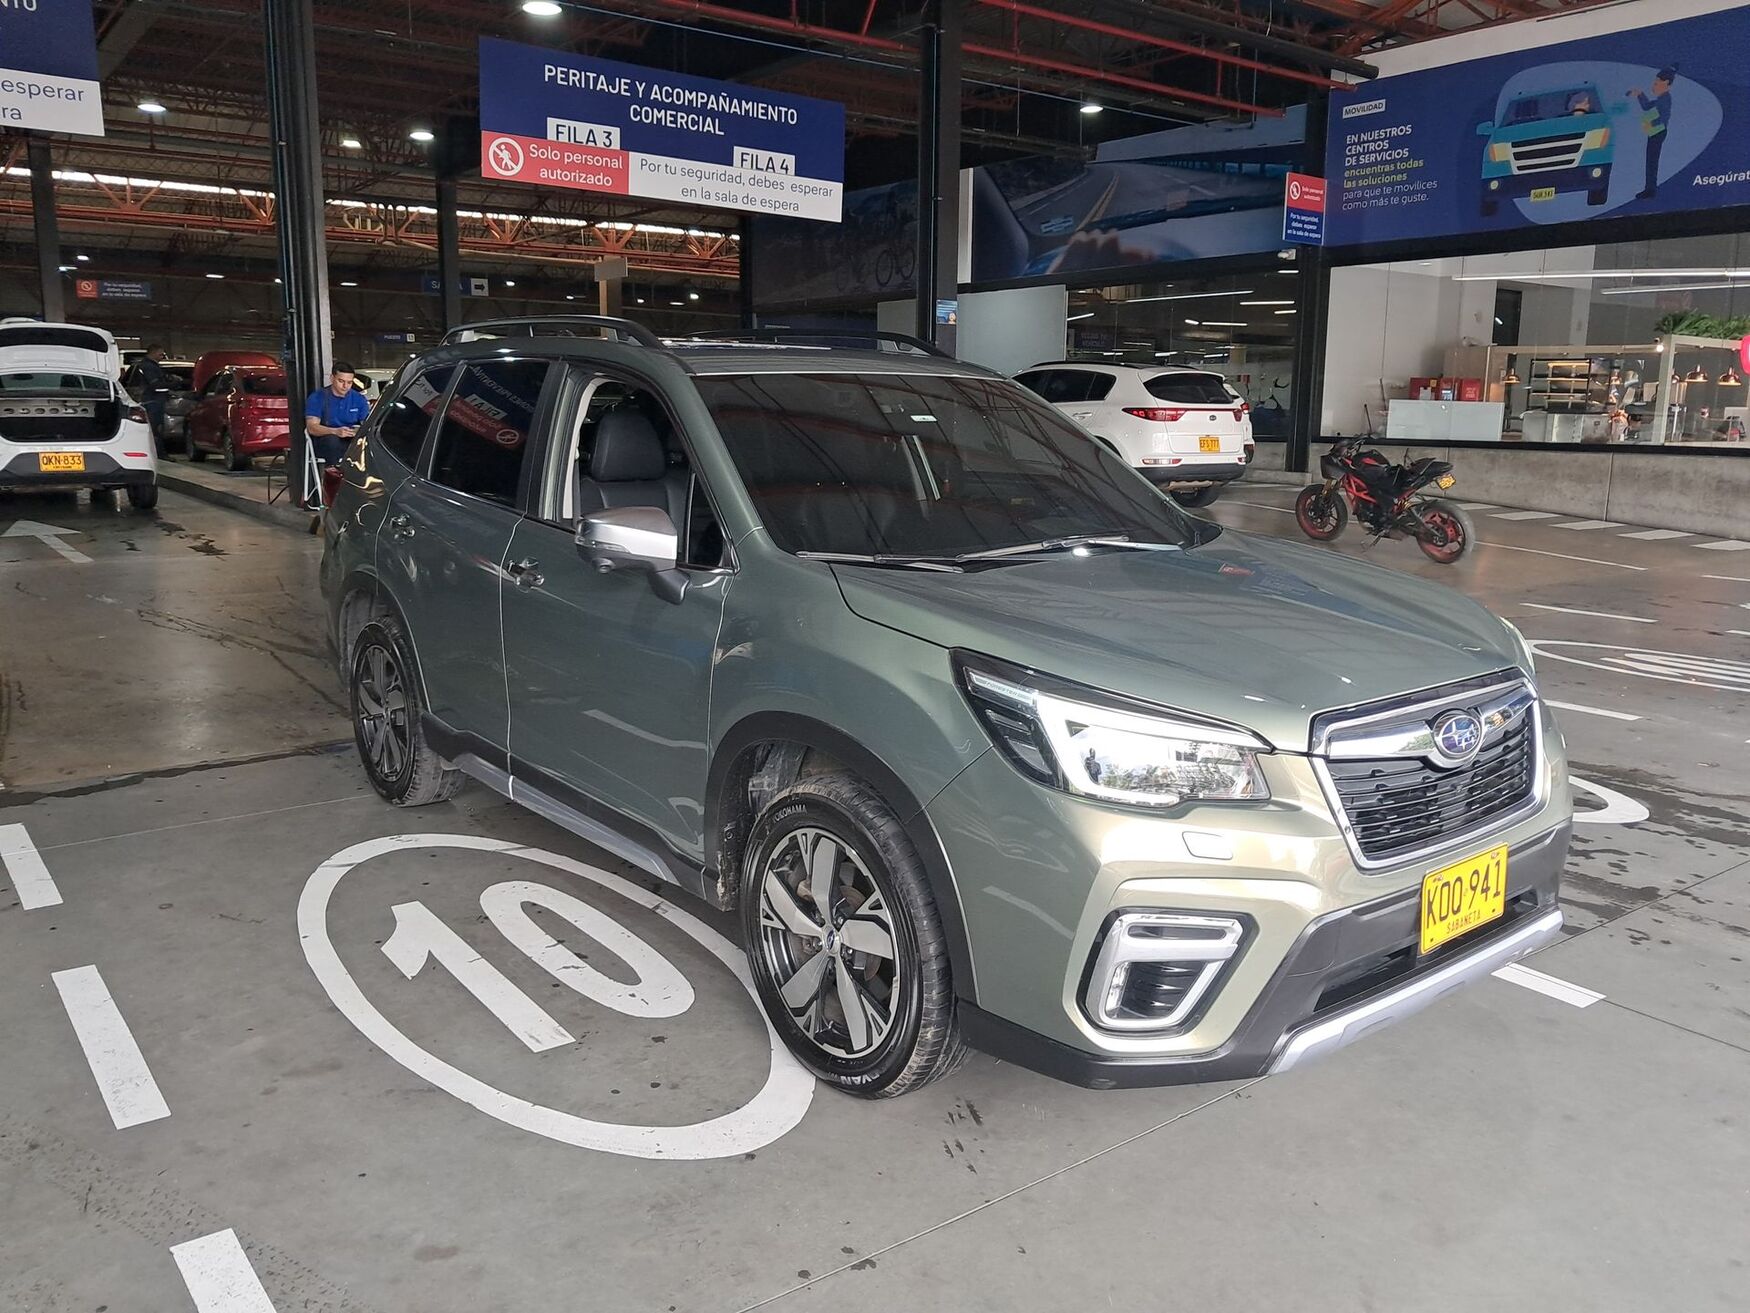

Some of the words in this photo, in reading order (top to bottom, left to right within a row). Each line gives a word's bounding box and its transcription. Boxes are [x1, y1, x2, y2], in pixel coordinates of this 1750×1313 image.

[1, 79, 84, 101] esperar
[544, 64, 631, 96] PERITAJE
[635, 80, 646, 98] Y
[650, 84, 798, 125] ACOMPAÑAMIENTO
[630, 104, 725, 136] COMERCIAL
[1344, 102, 1383, 116] MOVILIDAD
[556, 124, 598, 146] FILA
[602, 130, 612, 148] 3
[1346, 134, 1358, 144] EN
[1361, 124, 1412, 142] NUESTROS
[529, 144, 560, 160] Solo
[564, 151, 623, 169] personal
[1345, 140, 1389, 155] CENTROS
[1345, 156, 1357, 167] DE
[1359, 148, 1409, 165] SERVICIOS
[740, 152, 776, 173] FILA
[780, 158, 790, 175] 4
[1344, 165, 1394, 177] encuentras
[1397, 158, 1424, 170] todas
[540, 168, 613, 187] autorizado
[641, 158, 661, 172] Por
[664, 162, 677, 176] tu
[680, 166, 745, 187] seguridad,
[748, 174, 785, 191] debes
[790, 182, 833, 198] esperar
[1343, 179, 1356, 189] las
[1358, 172, 1407, 187] soluciones
[681, 187, 697, 198] en
[701, 187, 711, 200] la
[715, 189, 738, 204] sala
[742, 193, 757, 206] de
[760, 198, 799, 212] espera
[1343, 189, 1362, 201] para
[1364, 187, 1381, 200] que
[1383, 186, 1392, 194] te
[1394, 180, 1438, 193] movilices
[1342, 201, 1368, 211] como
[1370, 197, 1389, 207] más
[1390, 195, 1400, 204] te
[1402, 193, 1430, 206] guste.
[1446, 909, 1482, 935] SABANETA
[380, 881, 695, 1053] 10
